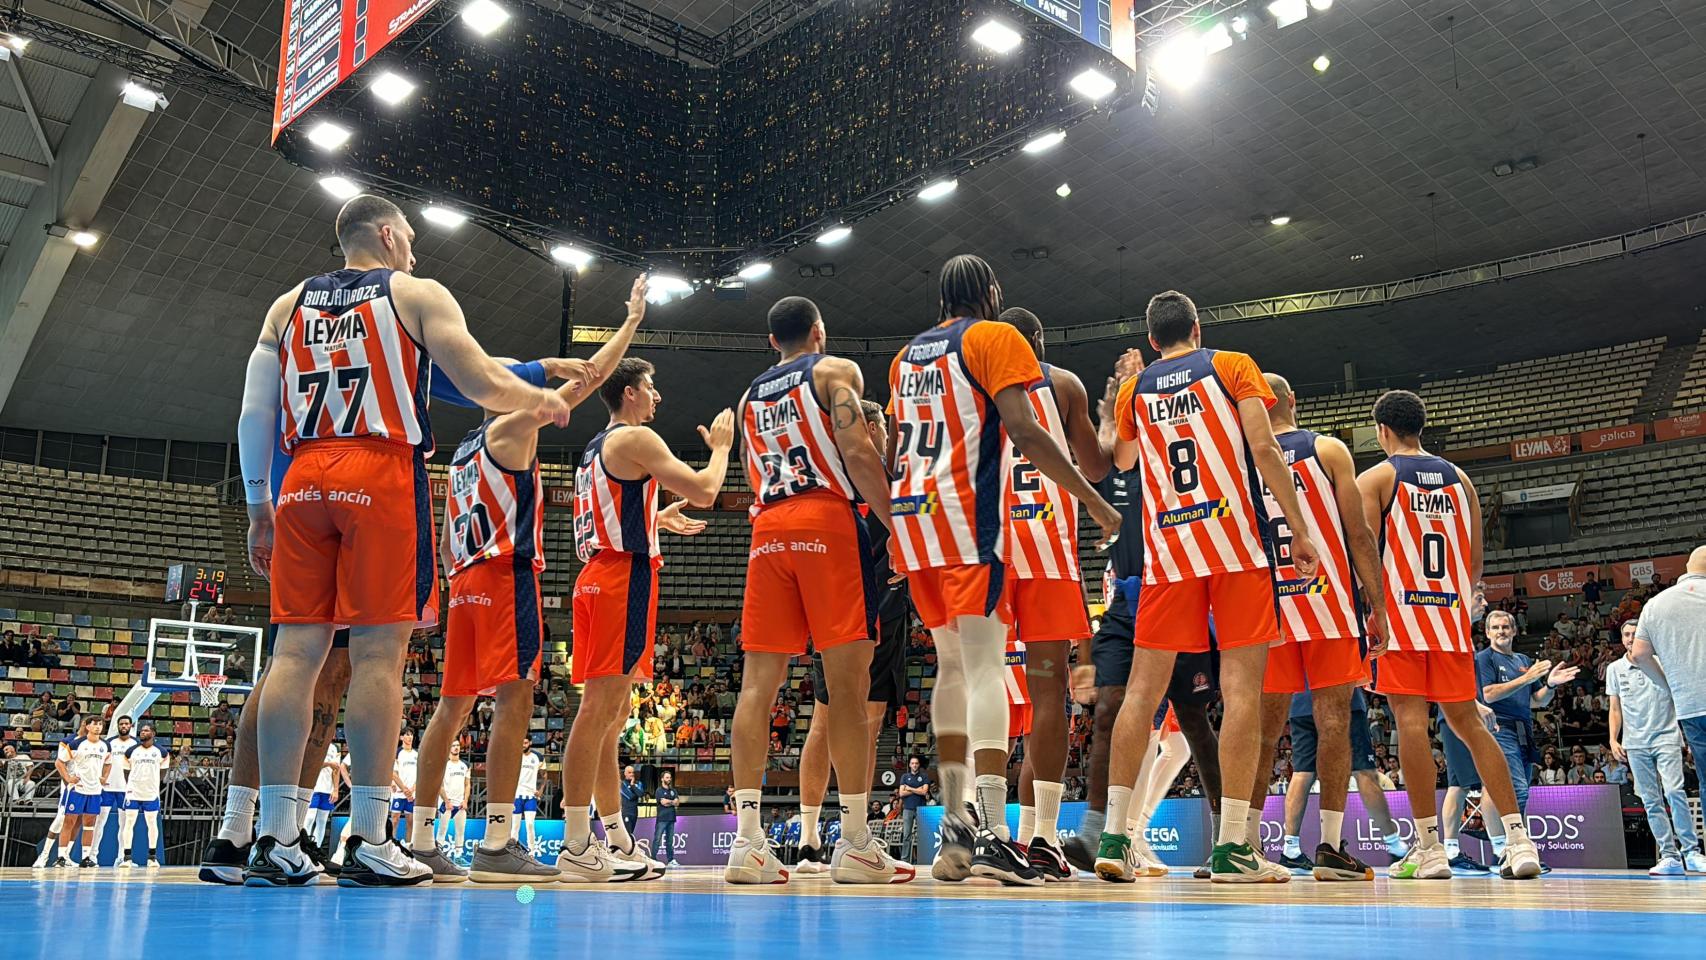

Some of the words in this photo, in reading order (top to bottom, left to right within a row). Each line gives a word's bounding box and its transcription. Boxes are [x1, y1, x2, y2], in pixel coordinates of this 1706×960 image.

[304, 285, 380, 306] BURJANADZE
[304, 313, 367, 346] LEYMA
[324, 343, 347, 352] NATURA
[900, 370, 944, 397] LEYMA
[1157, 369, 1192, 390] HUSKIC
[298, 366, 369, 437] 77
[1148, 392, 1204, 423] LEYMA
[757, 399, 801, 434] LEYMA
[1168, 417, 1189, 426] NATURA
[1590, 430, 1636, 449] galicia
[894, 421, 944, 482] 24
[1515, 440, 1553, 458] LEYMA
[761, 444, 818, 503] 23
[1168, 438, 1199, 494] 8
[1416, 472, 1444, 485] THIAM
[328, 488, 372, 506] ancín
[434, 482, 448, 496] LEY
[552, 489, 574, 503] LEYM
[890, 502, 915, 513] uman
[1411, 492, 1455, 514] LEYMA
[1162, 504, 1204, 526] Aluman
[790, 539, 828, 554] ancín
[1422, 534, 1446, 580] 0
[1632, 566, 1652, 576] GBS
[190, 581, 217, 599] 24
[1408, 594, 1446, 605] Aluman
[886, 774, 892, 784] 2
[1143, 828, 1180, 842] CEGA
[1374, 842, 1390, 852] Disp
[1548, 841, 1584, 850] Solutions
